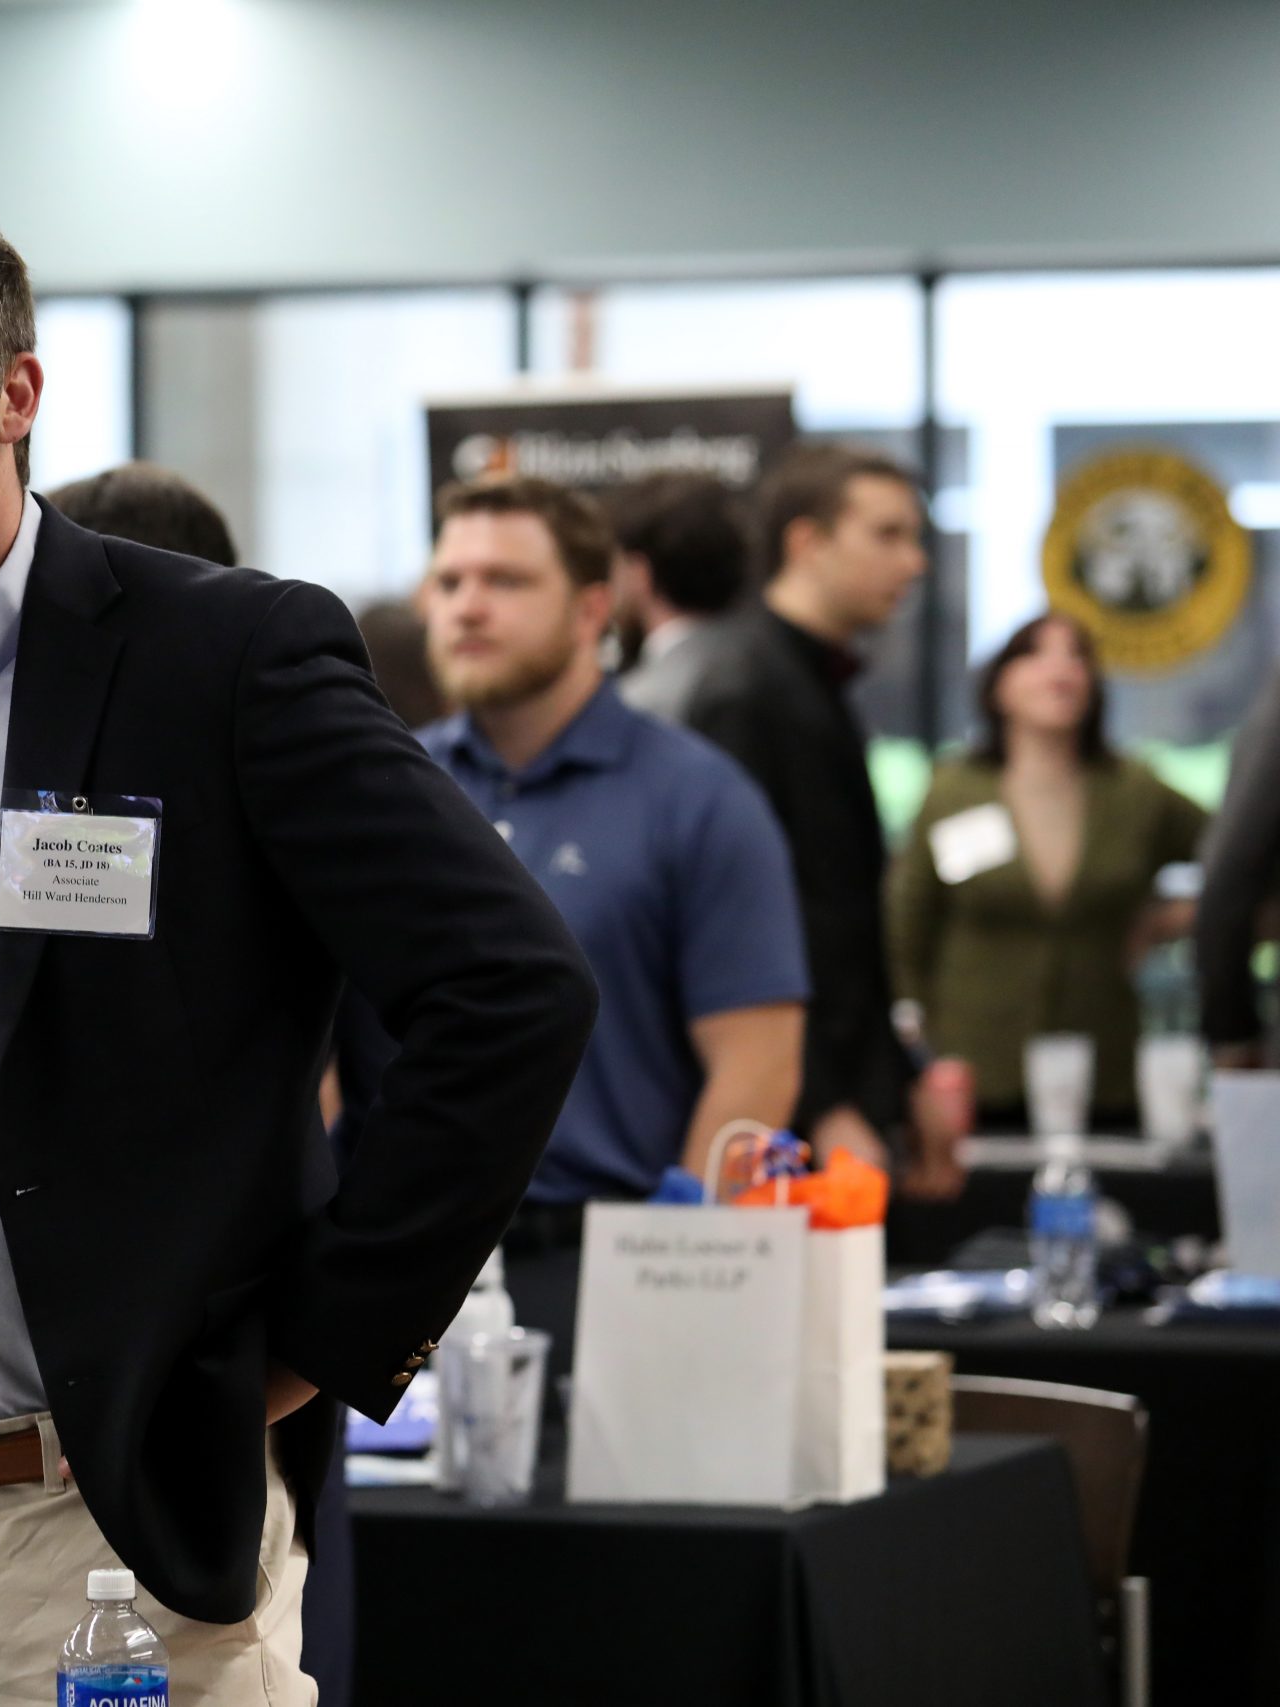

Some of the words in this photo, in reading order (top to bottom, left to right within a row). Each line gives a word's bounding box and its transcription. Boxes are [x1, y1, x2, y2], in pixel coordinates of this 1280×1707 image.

[32, 838, 72, 851] Jacob
[77, 840, 122, 854] Coates
[43, 859, 61, 868] (BA
[65, 860, 78, 869] 15,
[80, 861, 93, 870] JD
[96, 861, 110, 871] 18)
[52, 875, 100, 886] Associate
[23, 890, 42, 900] Hill
[45, 891, 72, 902] Ward
[75, 893, 127, 905] Henderson
[89, 1694, 166, 1707] AQUAFINA
